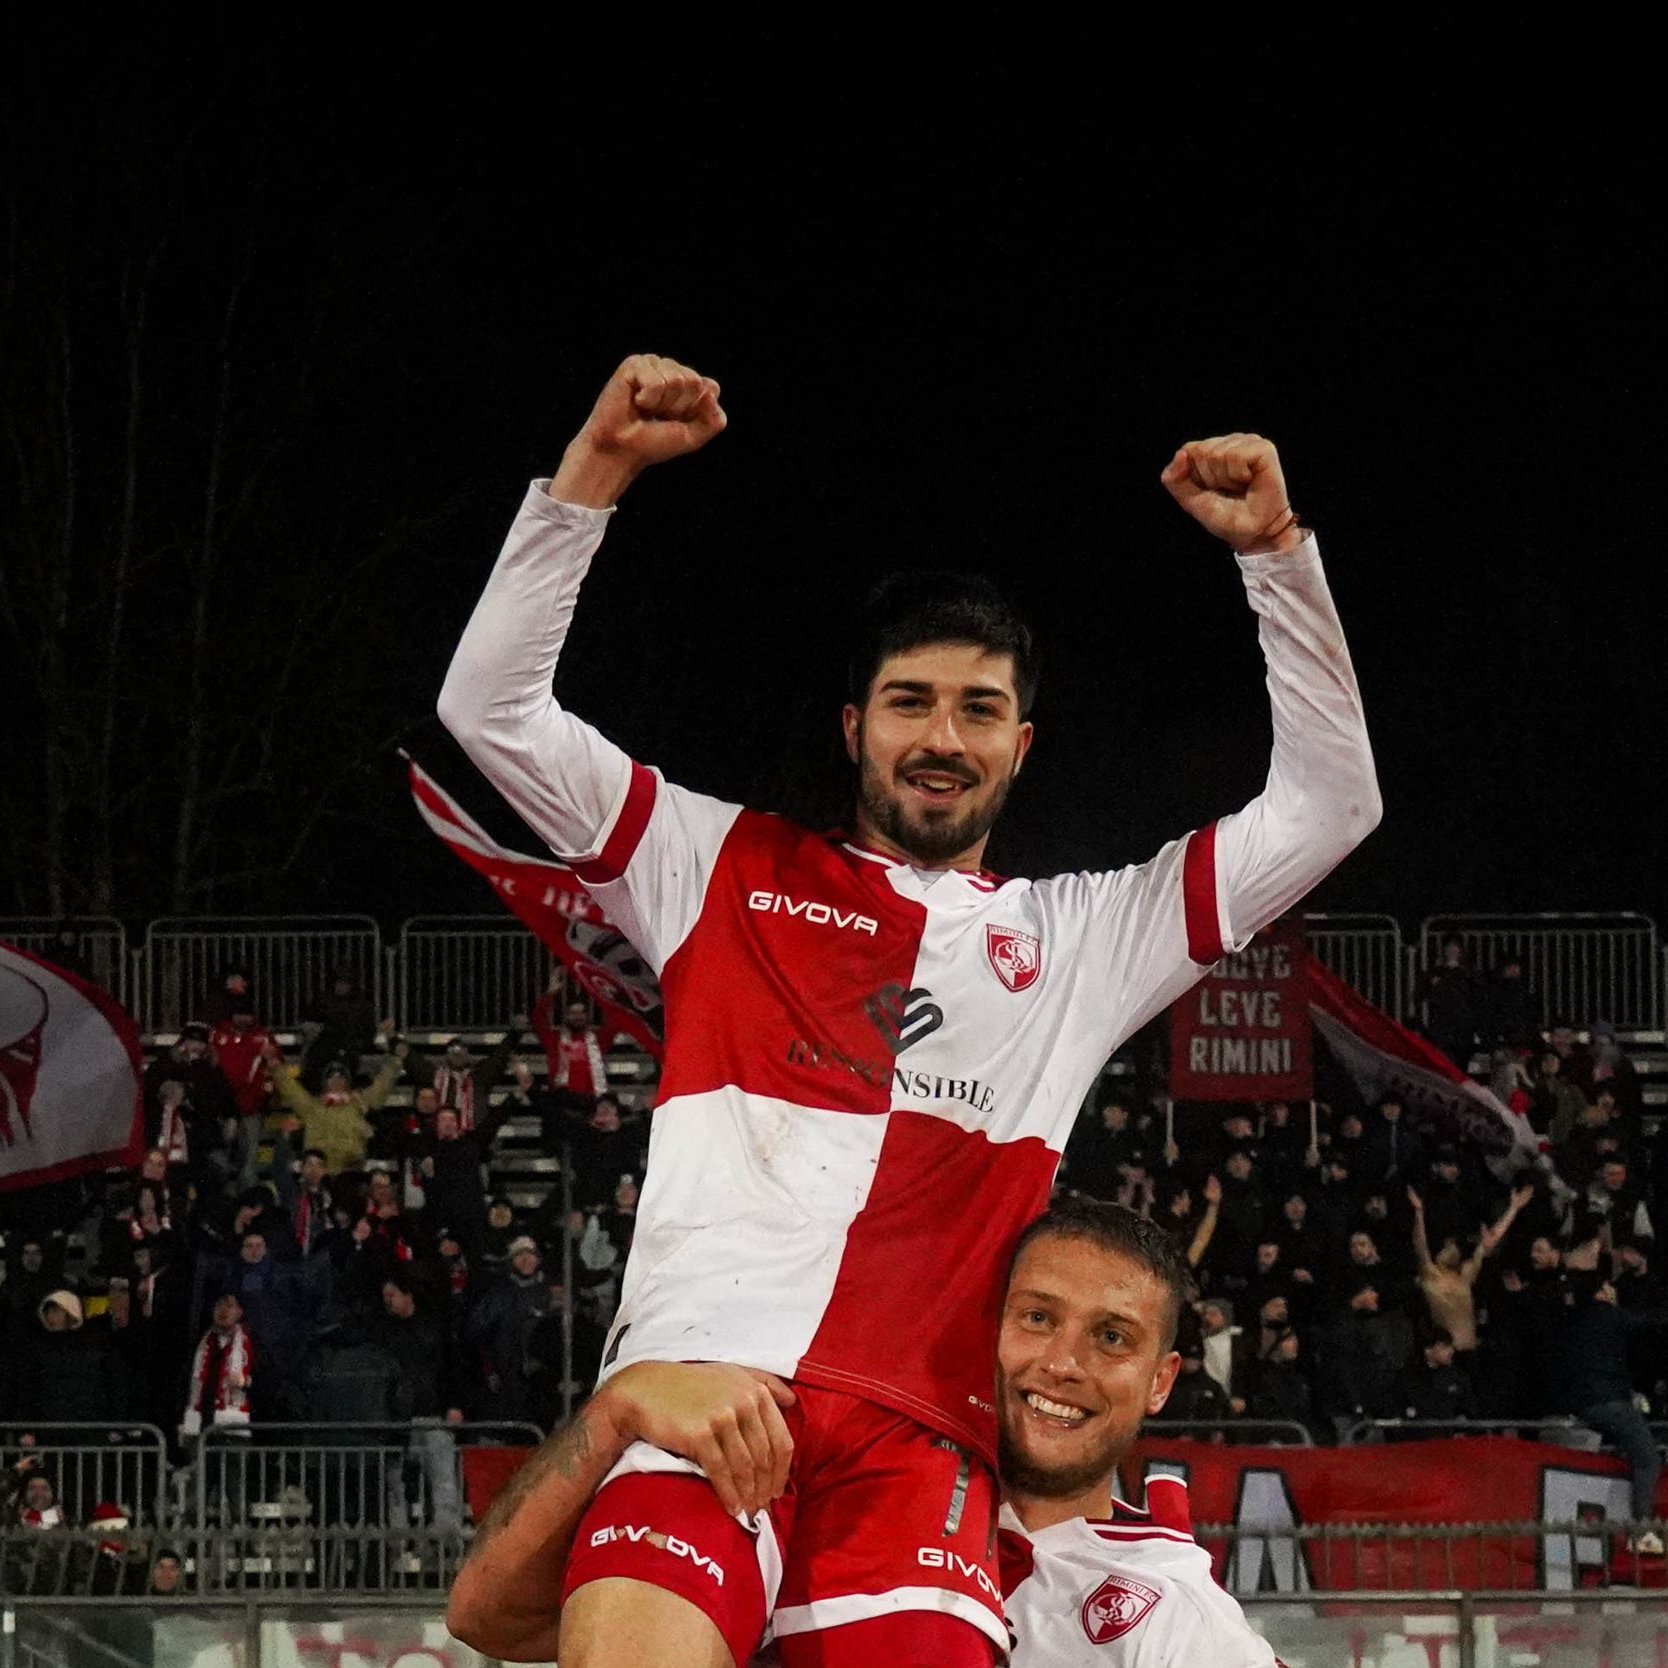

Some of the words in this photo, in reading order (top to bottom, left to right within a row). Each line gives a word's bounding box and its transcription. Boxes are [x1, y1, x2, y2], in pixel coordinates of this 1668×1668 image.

[748, 890, 879, 936] GIVOVA
[1189, 1036, 1292, 1074] RIMINI
[967, 1394, 996, 1413] GIVO
[589, 1524, 725, 1587] GIVOVA
[917, 1547, 1004, 1611] GIVOV
